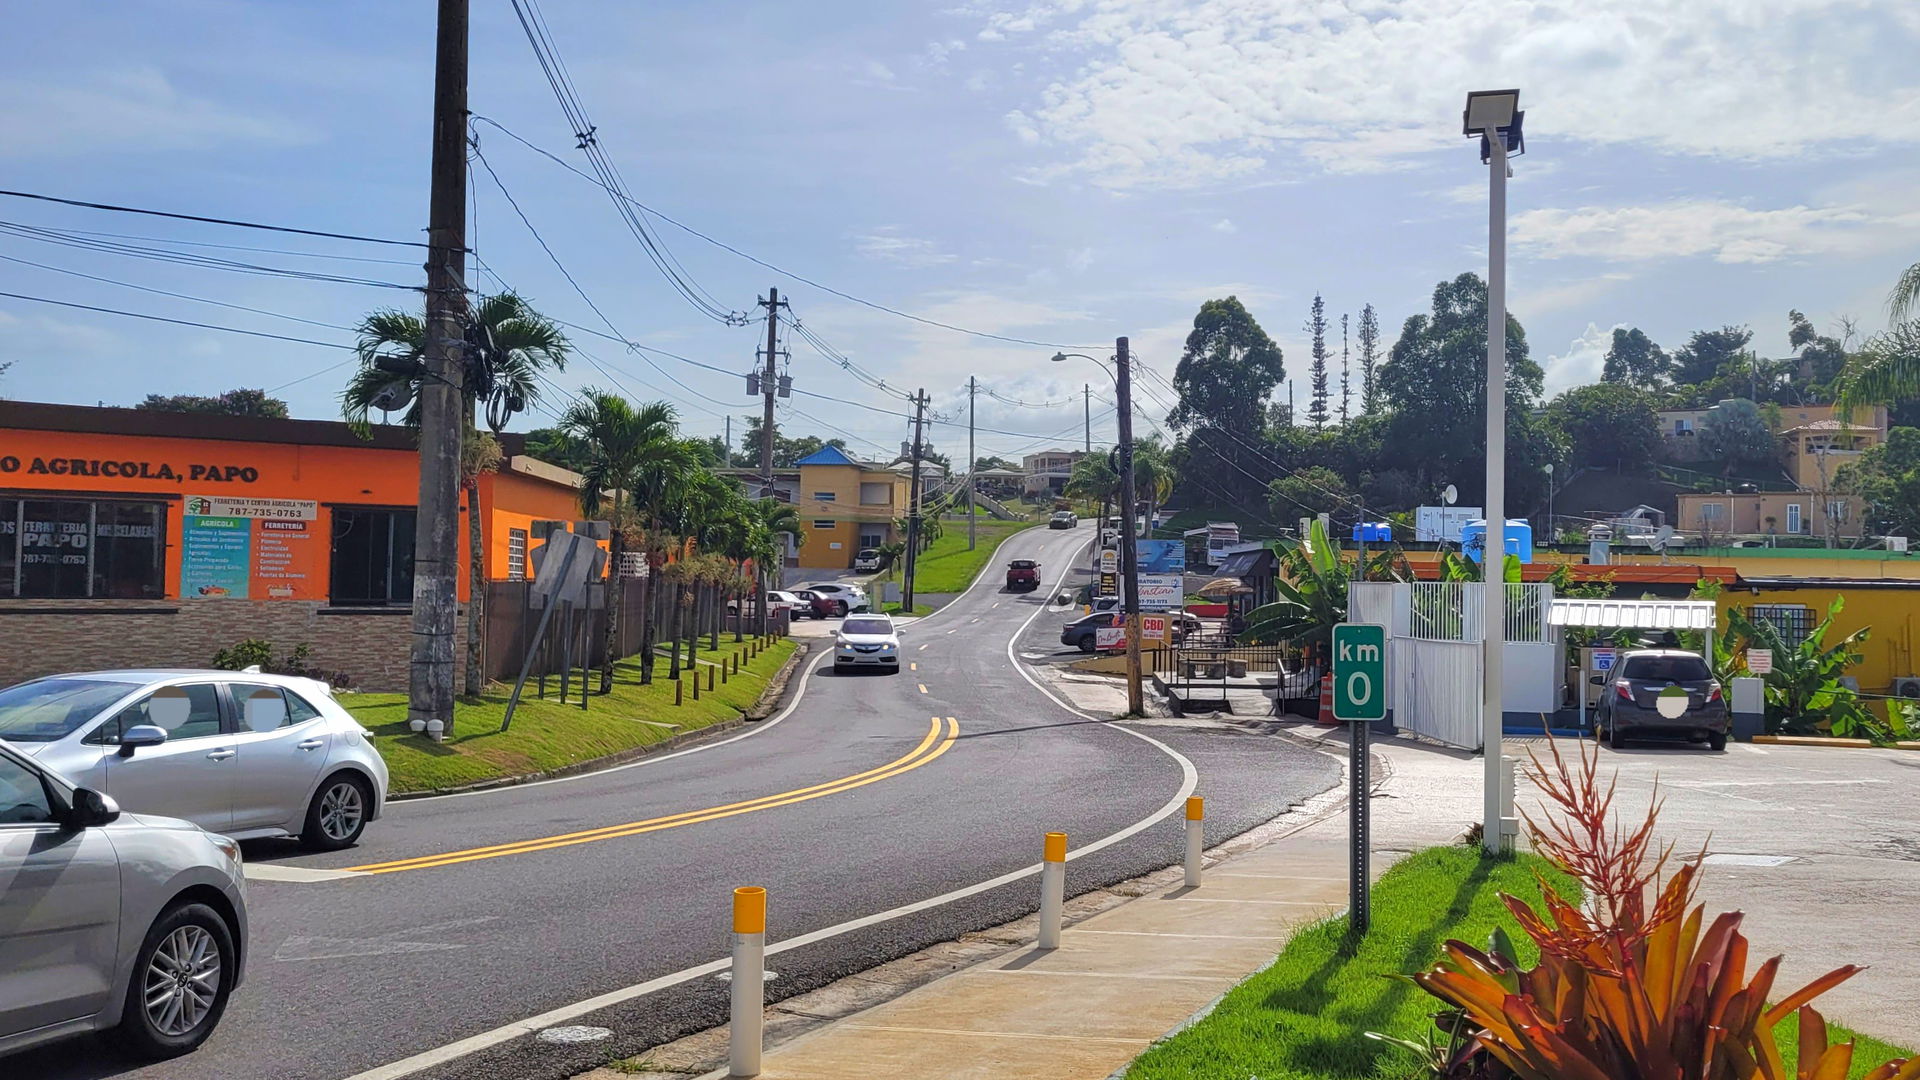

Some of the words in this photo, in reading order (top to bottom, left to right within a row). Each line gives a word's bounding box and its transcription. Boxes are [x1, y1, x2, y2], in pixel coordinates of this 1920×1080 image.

[0, 456, 21, 473] O
[27, 458, 183, 483] AGRICOLA,
[189, 464, 259, 483] PAPO
[229, 507, 302, 518] 787-735-0763
[264, 521, 304, 530] FERRETERÍA
[23, 554, 86, 564] 787-7-0763
[1143, 619, 1163, 631] CBD
[1340, 639, 1379, 662] km
[1347, 671, 1371, 706] 0
